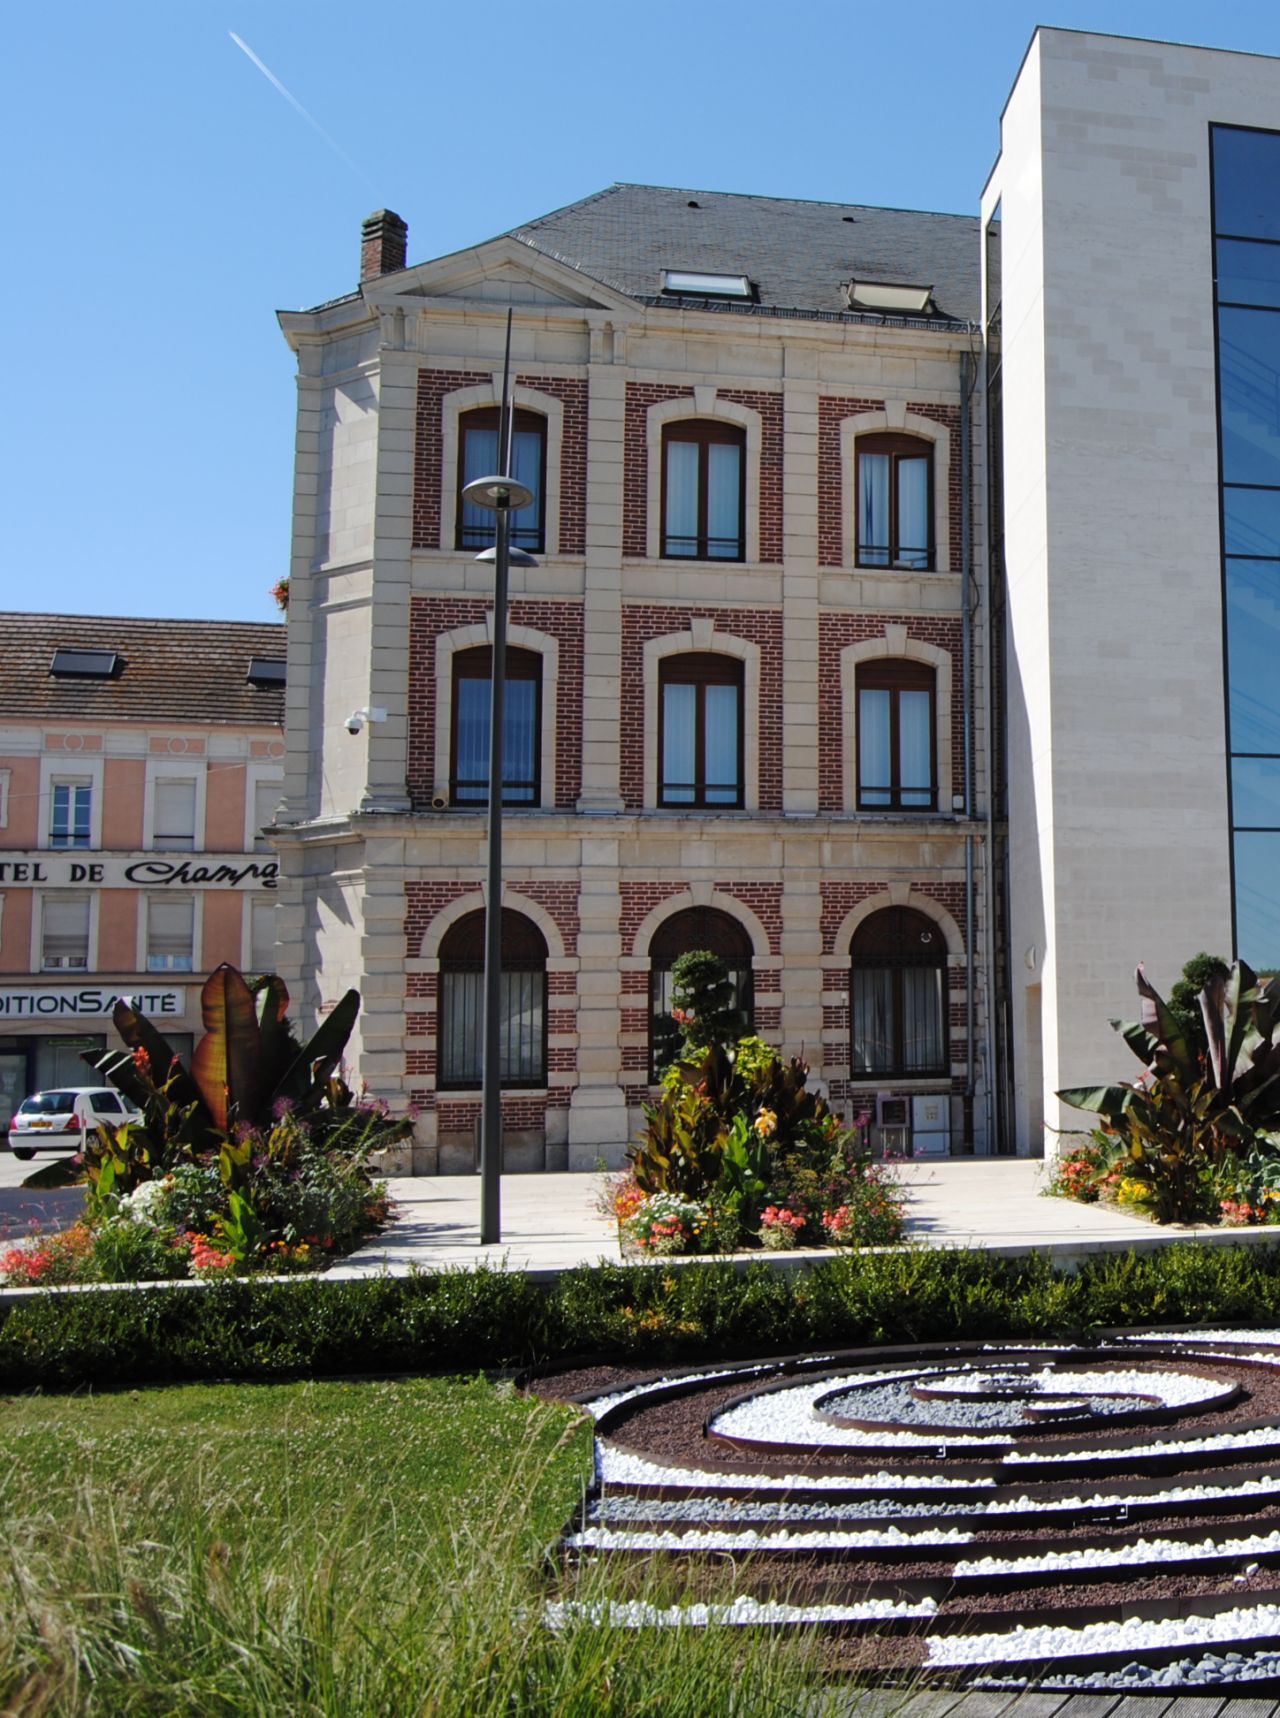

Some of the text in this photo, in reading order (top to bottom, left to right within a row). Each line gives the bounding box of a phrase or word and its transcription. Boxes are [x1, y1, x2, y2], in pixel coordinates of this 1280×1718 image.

[70, 863, 105, 882] DE
[125, 861, 279, 888] Champa
[0, 991, 176, 1013] ITIONSNTÉ
